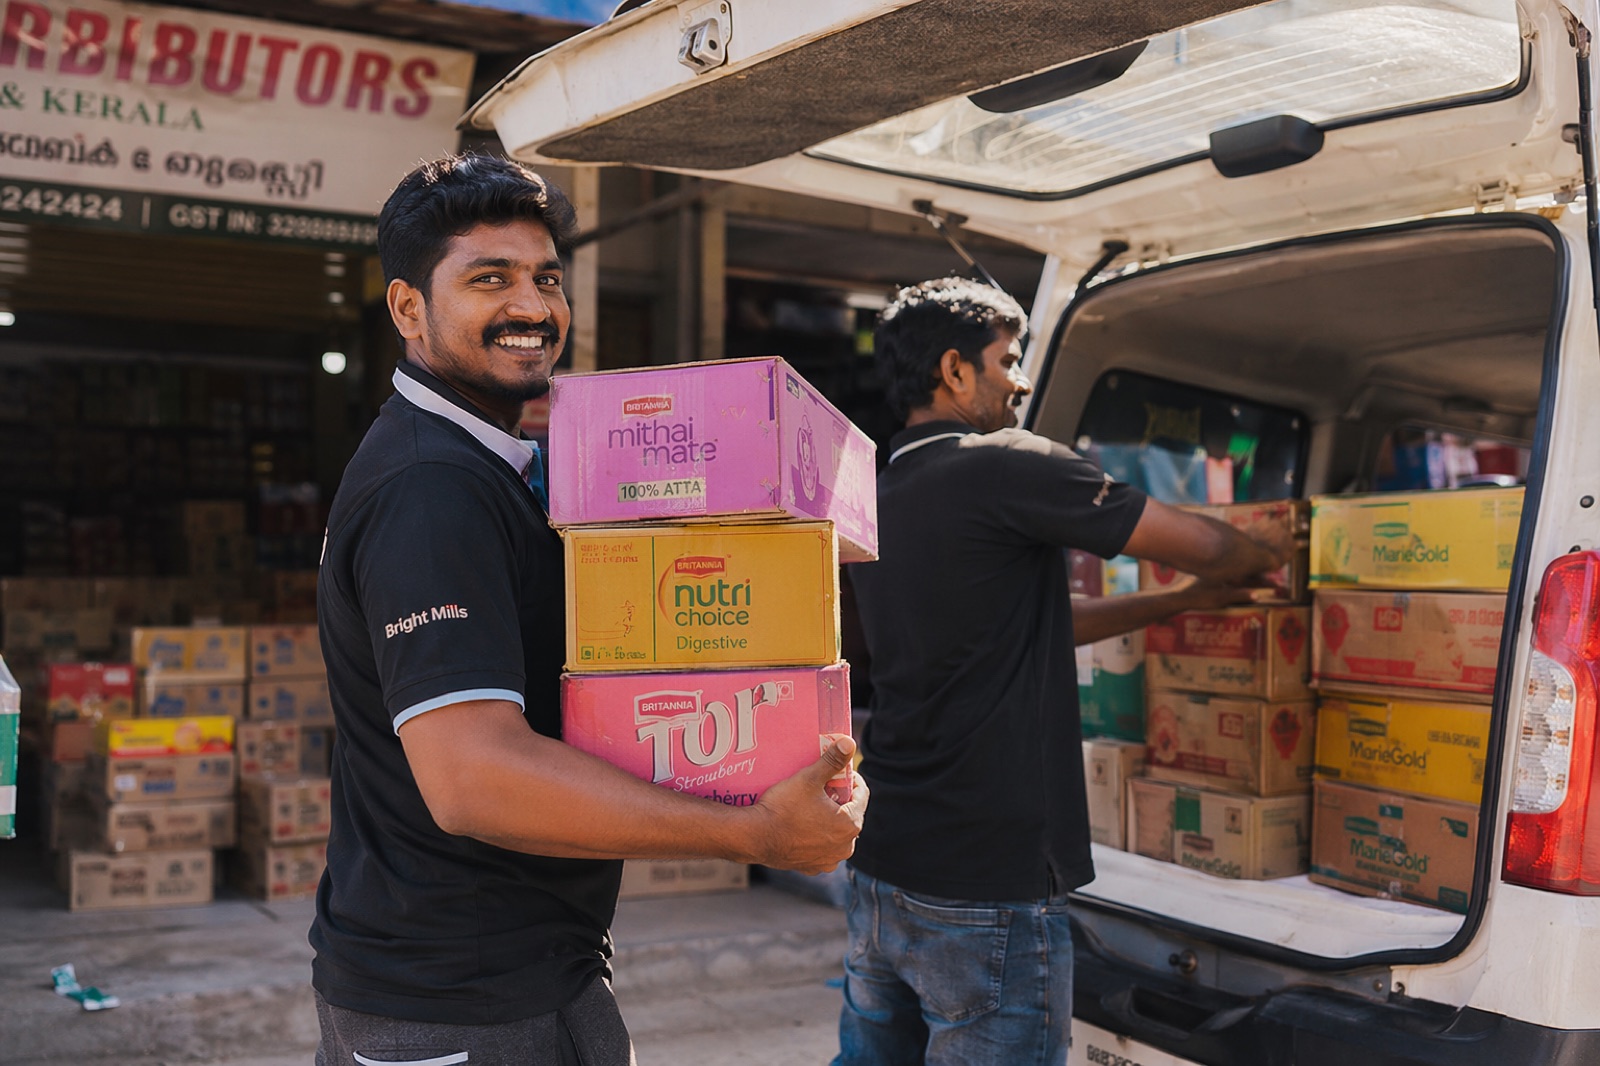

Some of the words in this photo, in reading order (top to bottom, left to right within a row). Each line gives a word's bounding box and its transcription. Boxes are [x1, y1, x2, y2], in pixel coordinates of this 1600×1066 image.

[0, 0, 439, 119] RBIBUTORS
[0, 82, 26, 110] &
[42, 87, 205, 132] KERALA
[2, 186, 122, 221] 242424
[169, 203, 223, 230] GST
[608, 416, 694, 449] mithai
[643, 441, 717, 466] mate
[621, 484, 660, 499] 100%
[663, 480, 702, 496] ATTA
[677, 561, 723, 570] BRITANNIA
[1373, 545, 1449, 563] MarieGold
[674, 578, 750, 608] nutri
[385, 610, 429, 639] Bright
[430, 604, 469, 622] Mills
[674, 608, 750, 627] choice
[676, 635, 748, 653] Digestive
[642, 700, 694, 712] BRITANNIA
[636, 681, 778, 784] Tor
[1349, 740, 1427, 769] MarieGold
[1350, 838, 1428, 875] MarieGold
